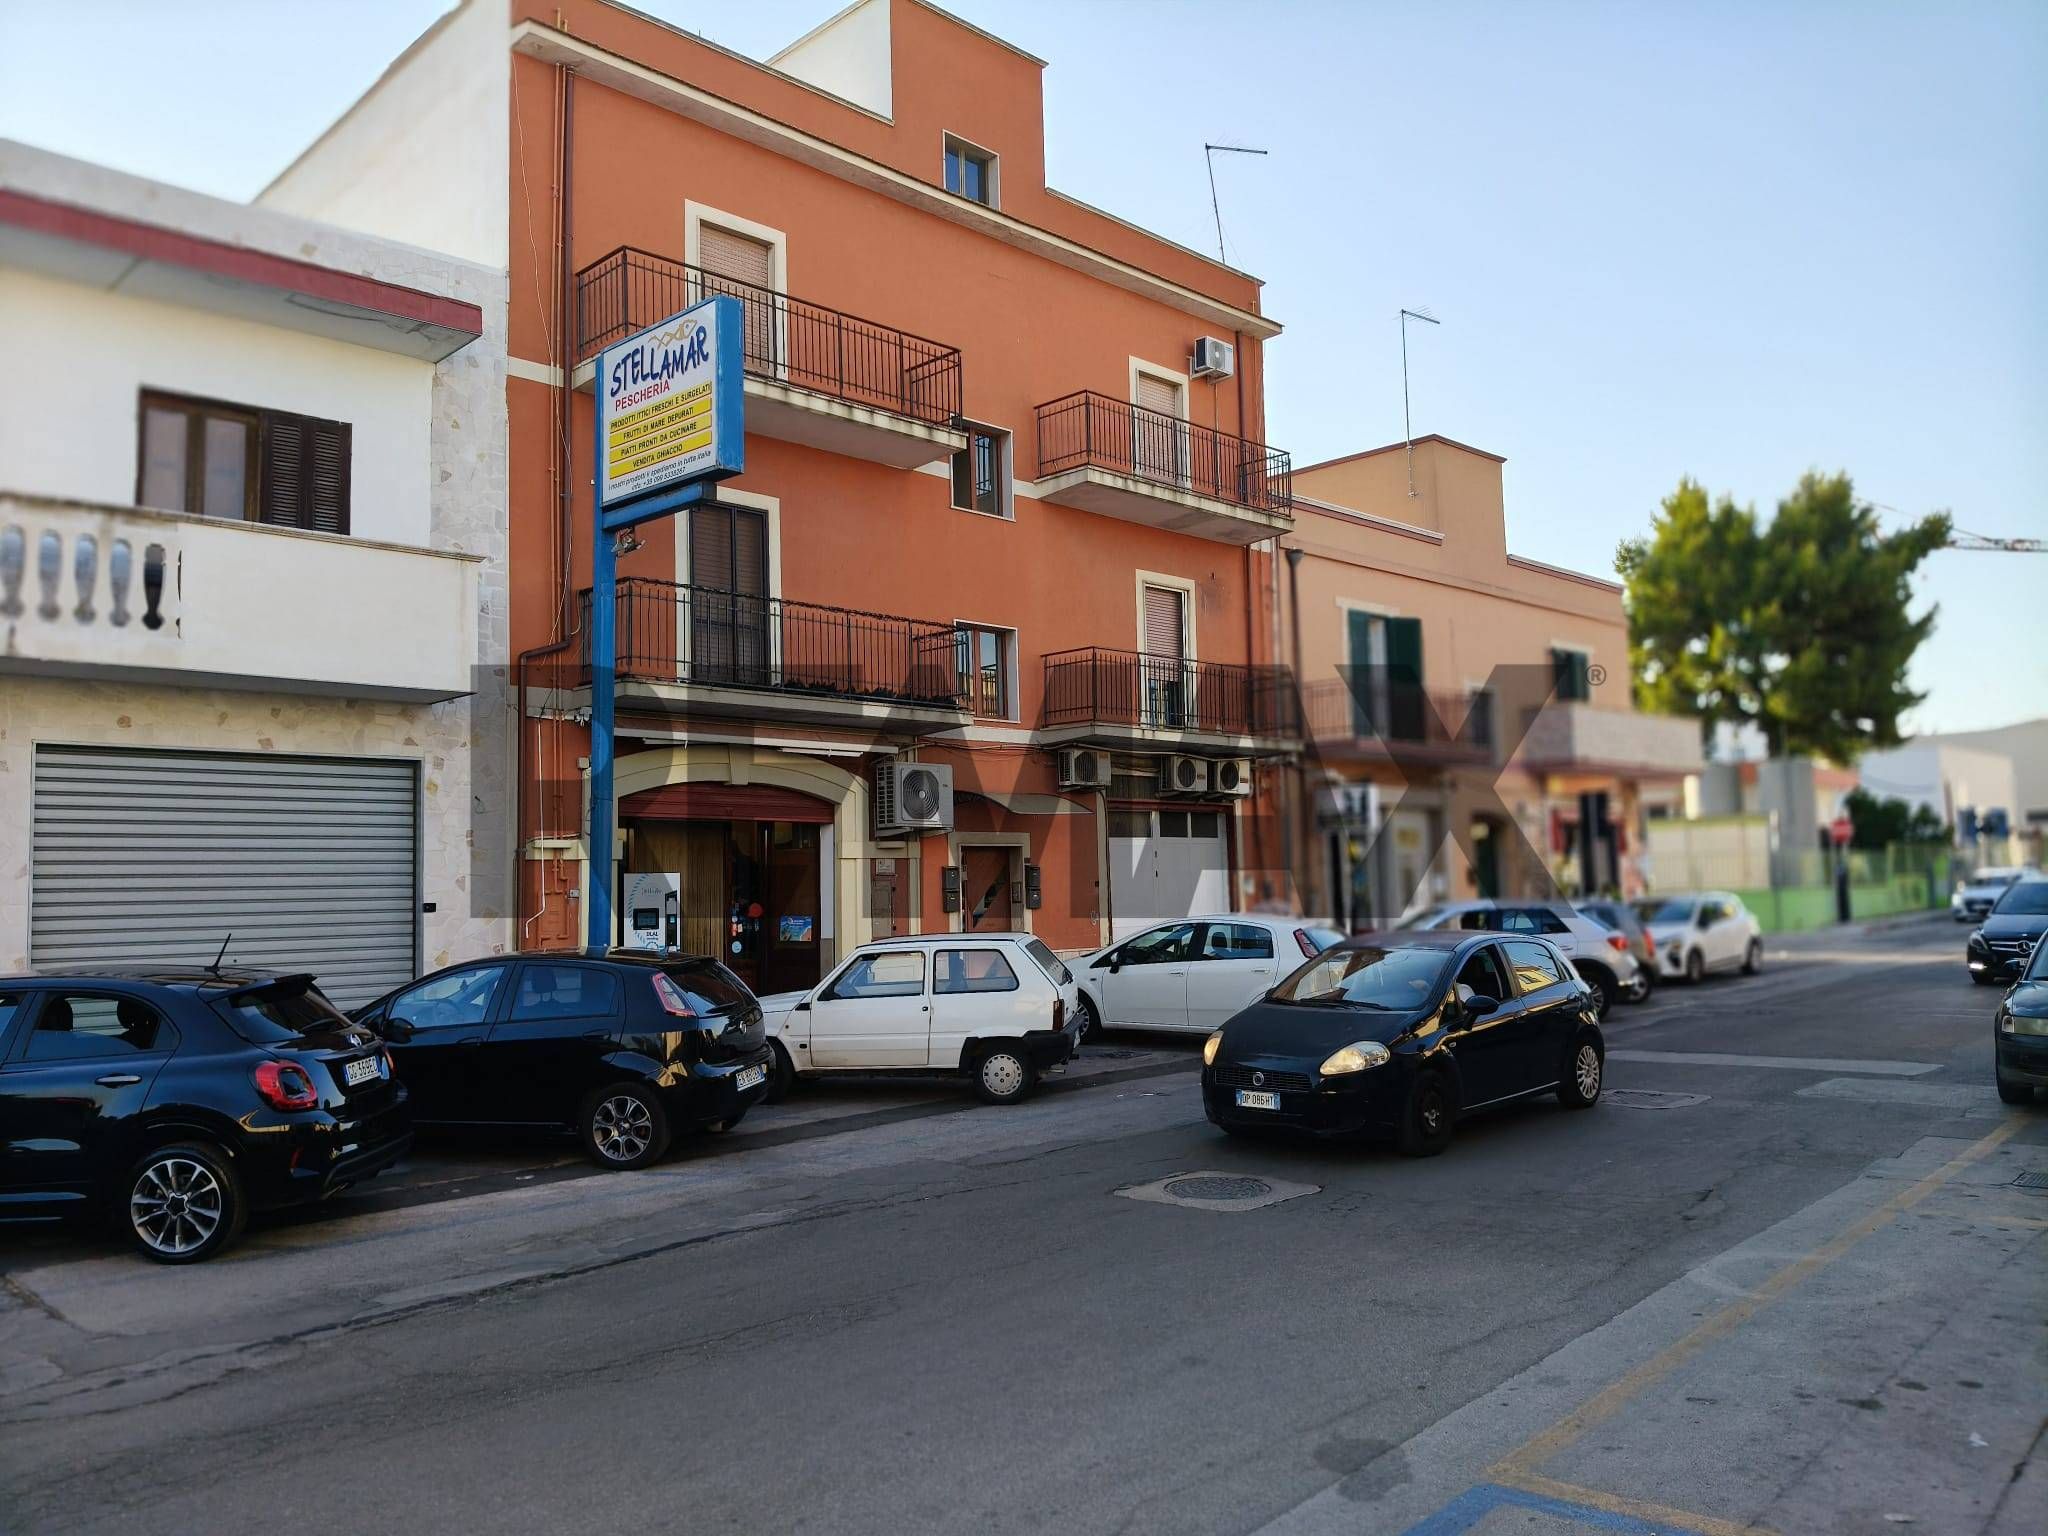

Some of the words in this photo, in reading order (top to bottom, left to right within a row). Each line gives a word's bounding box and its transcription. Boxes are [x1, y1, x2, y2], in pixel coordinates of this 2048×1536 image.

[611, 326, 709, 397] STELLAMAR
[615, 380, 670, 412] PESCHERIA
[611, 415, 636, 430] PRODOTTI
[637, 408, 651, 420] ITTICI
[652, 399, 674, 417] FRESCHI
[623, 428, 642, 440] FRUTTI
[650, 417, 665, 430] MARE
[667, 407, 694, 423] DEPURATI
[621, 445, 637, 456] PIATTI
[639, 436, 658, 449] PRONTI
[670, 421, 697, 438] CUCINARE
[632, 455, 655, 467] VENDITA
[657, 443, 683, 459] GHIACCIO
